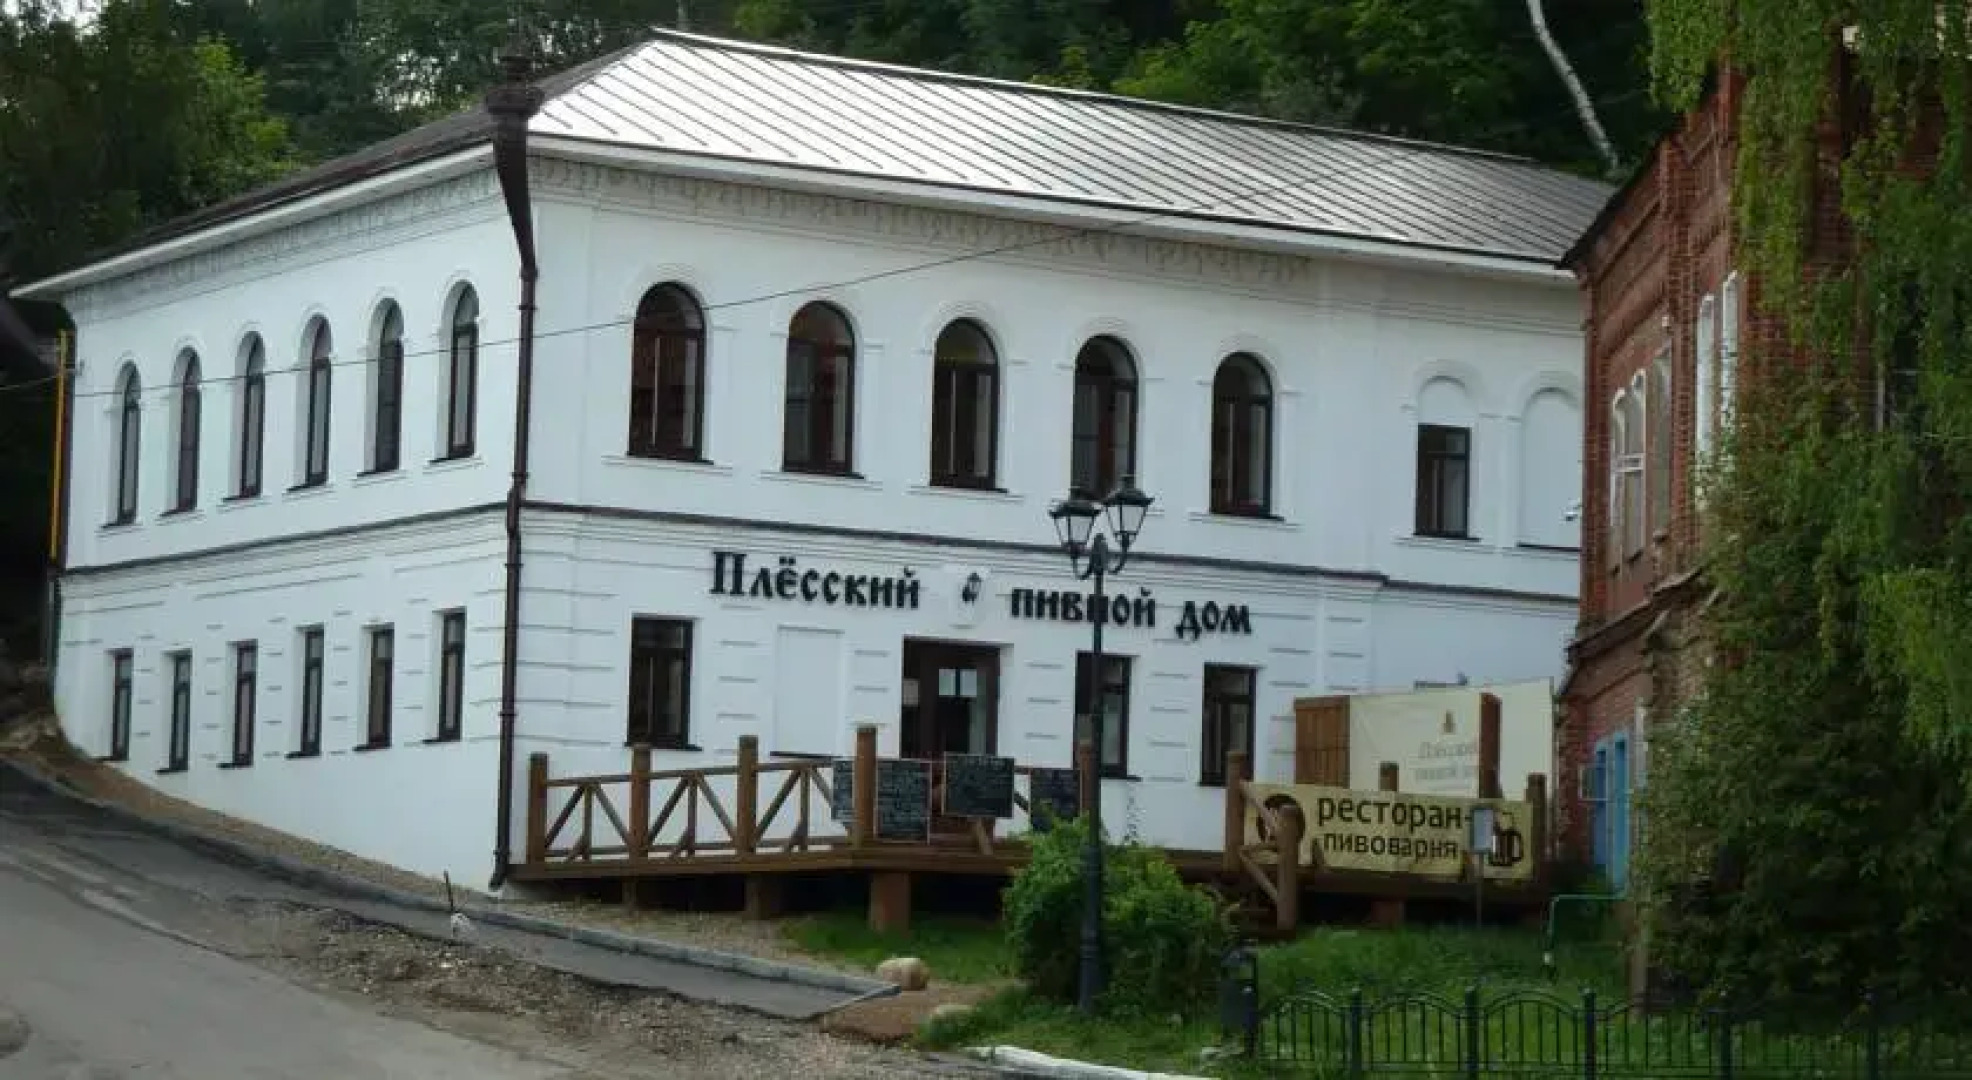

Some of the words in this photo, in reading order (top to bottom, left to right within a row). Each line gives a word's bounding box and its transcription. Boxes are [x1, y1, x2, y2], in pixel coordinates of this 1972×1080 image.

[709, 551, 920, 609] Плёсский
[1175, 601, 1252, 640] дом
[1322, 833, 1459, 862] пивоварня
